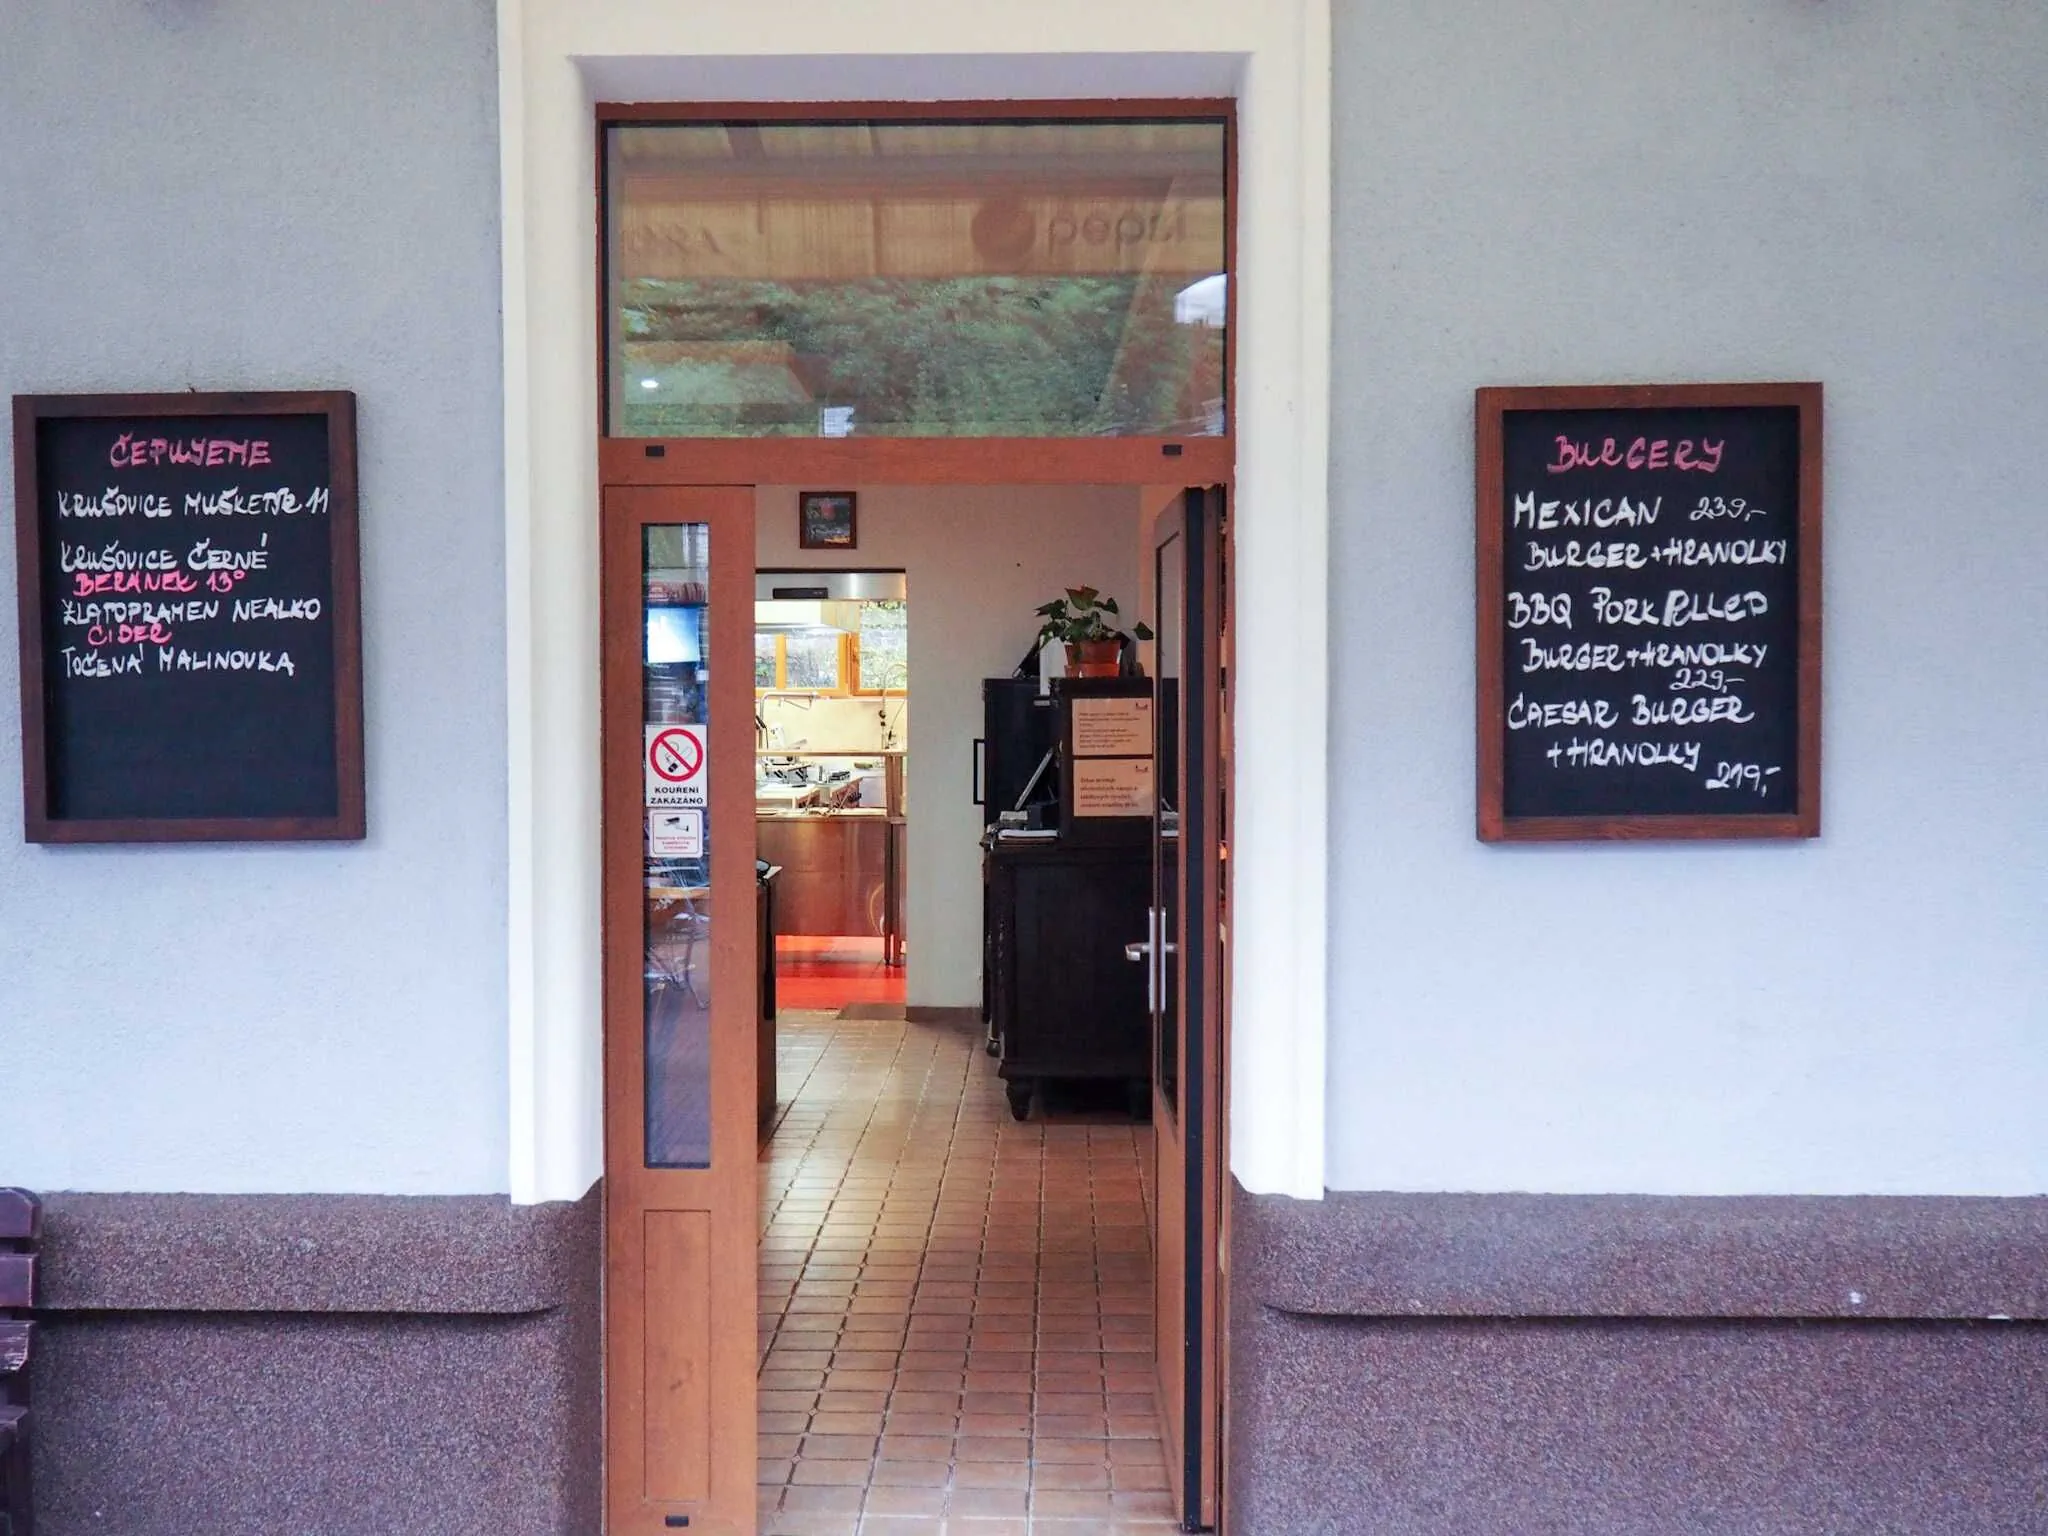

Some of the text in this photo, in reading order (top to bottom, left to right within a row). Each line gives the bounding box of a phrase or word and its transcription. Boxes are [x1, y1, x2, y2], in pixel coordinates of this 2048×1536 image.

[1547, 435, 1725, 473] BURGERY
[58, 486, 172, 517] KRUŠOVICE
[1514, 489, 1662, 530] MEXICAN
[61, 540, 177, 572] KRUŠOVICE
[1524, 540, 1648, 571] BURGER
[233, 597, 321, 622] NEALKO
[1508, 592, 1572, 629] BBQ
[1589, 586, 1659, 626] PORK
[87, 622, 172, 645] CIDER
[160, 646, 294, 677] MALINOVKA
[1507, 692, 1755, 729] CAESAR BURGER
